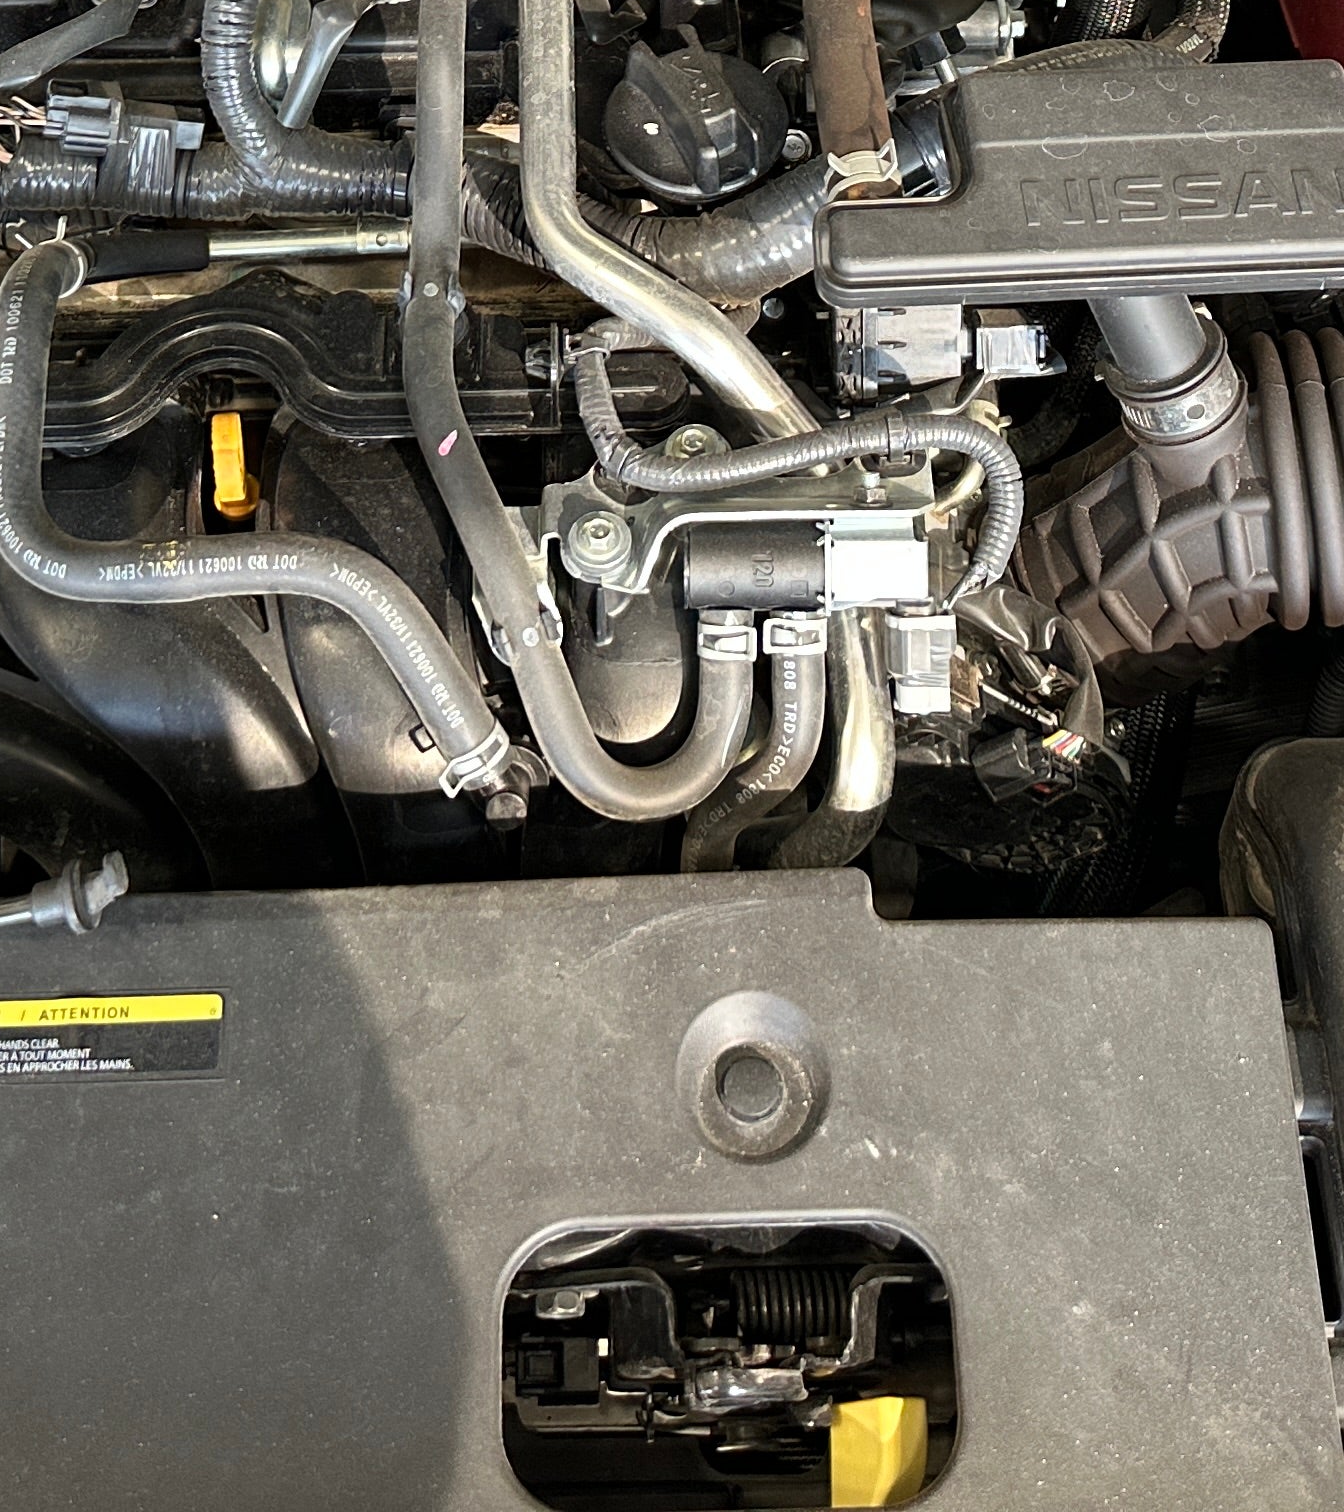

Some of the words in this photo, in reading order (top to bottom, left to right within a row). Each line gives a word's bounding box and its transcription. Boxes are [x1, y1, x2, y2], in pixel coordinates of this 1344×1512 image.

[6, 289, 25, 332] 100621
[42, 561, 67, 579] DOT
[198, 556, 243, 575] 100621
[272, 554, 299, 571] DOT
[406, 639, 438, 684] 100621
[441, 703, 465, 729] DOT
[39, 1005, 130, 1021] ATTENTION
[19, 1049, 46, 1060] TOUT
[47, 1048, 92, 1059] MOMENT
[7, 1062, 21, 1073] EN
[21, 1059, 80, 1072] APPROCHER
[81, 1059, 99, 1070] LES
[99, 1058, 136, 1070] MAINS.
